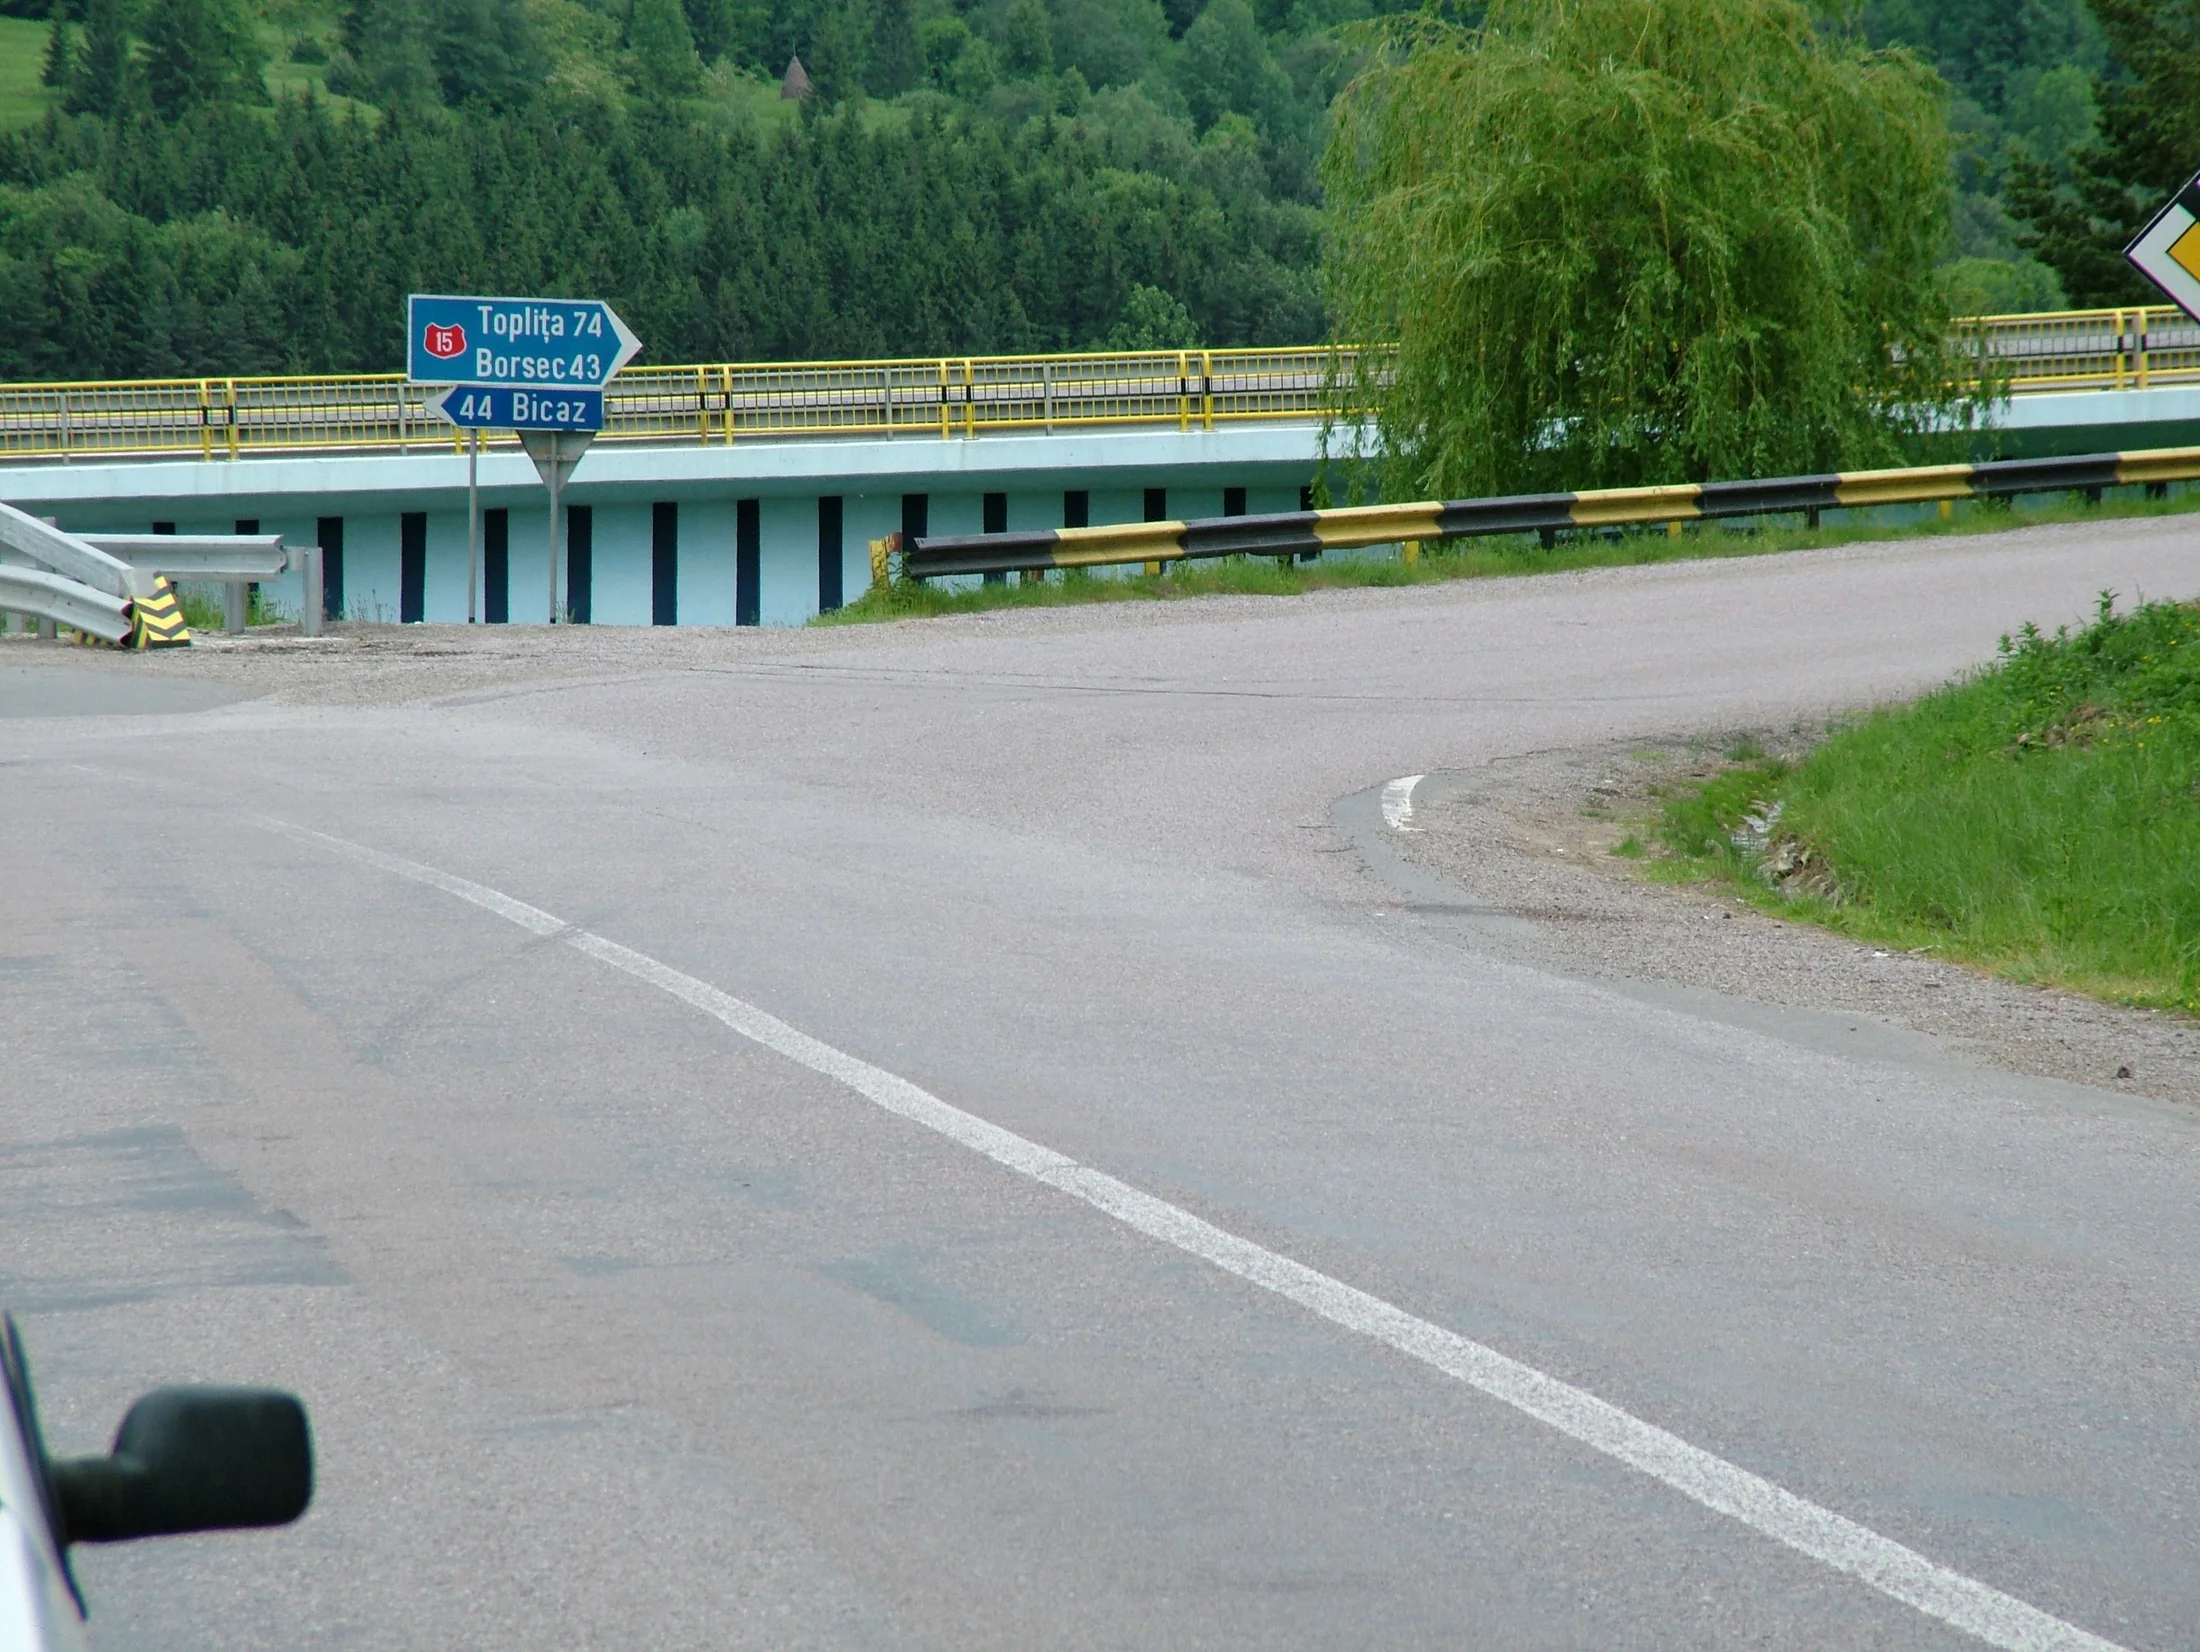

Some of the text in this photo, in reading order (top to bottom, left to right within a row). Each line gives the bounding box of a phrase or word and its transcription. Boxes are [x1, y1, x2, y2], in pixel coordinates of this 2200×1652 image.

[573, 311, 602, 338] 74
[436, 331, 453, 352] 15
[476, 348, 600, 380] Borsec 43
[459, 392, 586, 423] 44 Bicaz
